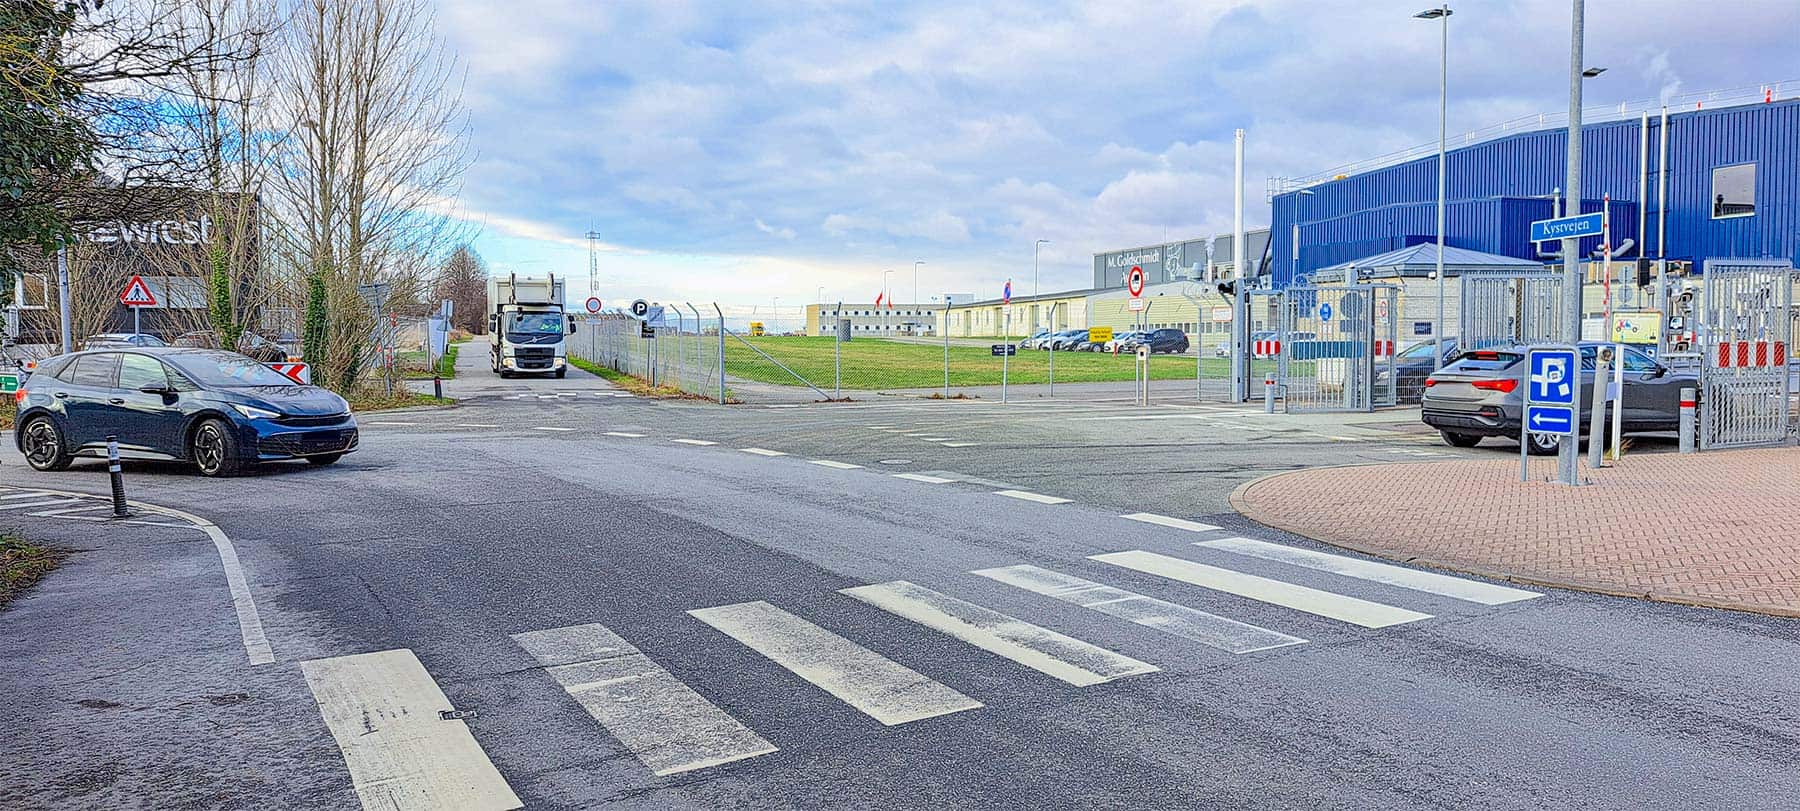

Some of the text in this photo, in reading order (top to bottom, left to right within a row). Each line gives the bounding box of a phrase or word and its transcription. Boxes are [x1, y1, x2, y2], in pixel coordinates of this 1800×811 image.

[1543, 220, 1590, 238] Kystvejen
[1117, 249, 1159, 266] Goldschmidt
[636, 303, 645, 314] P
